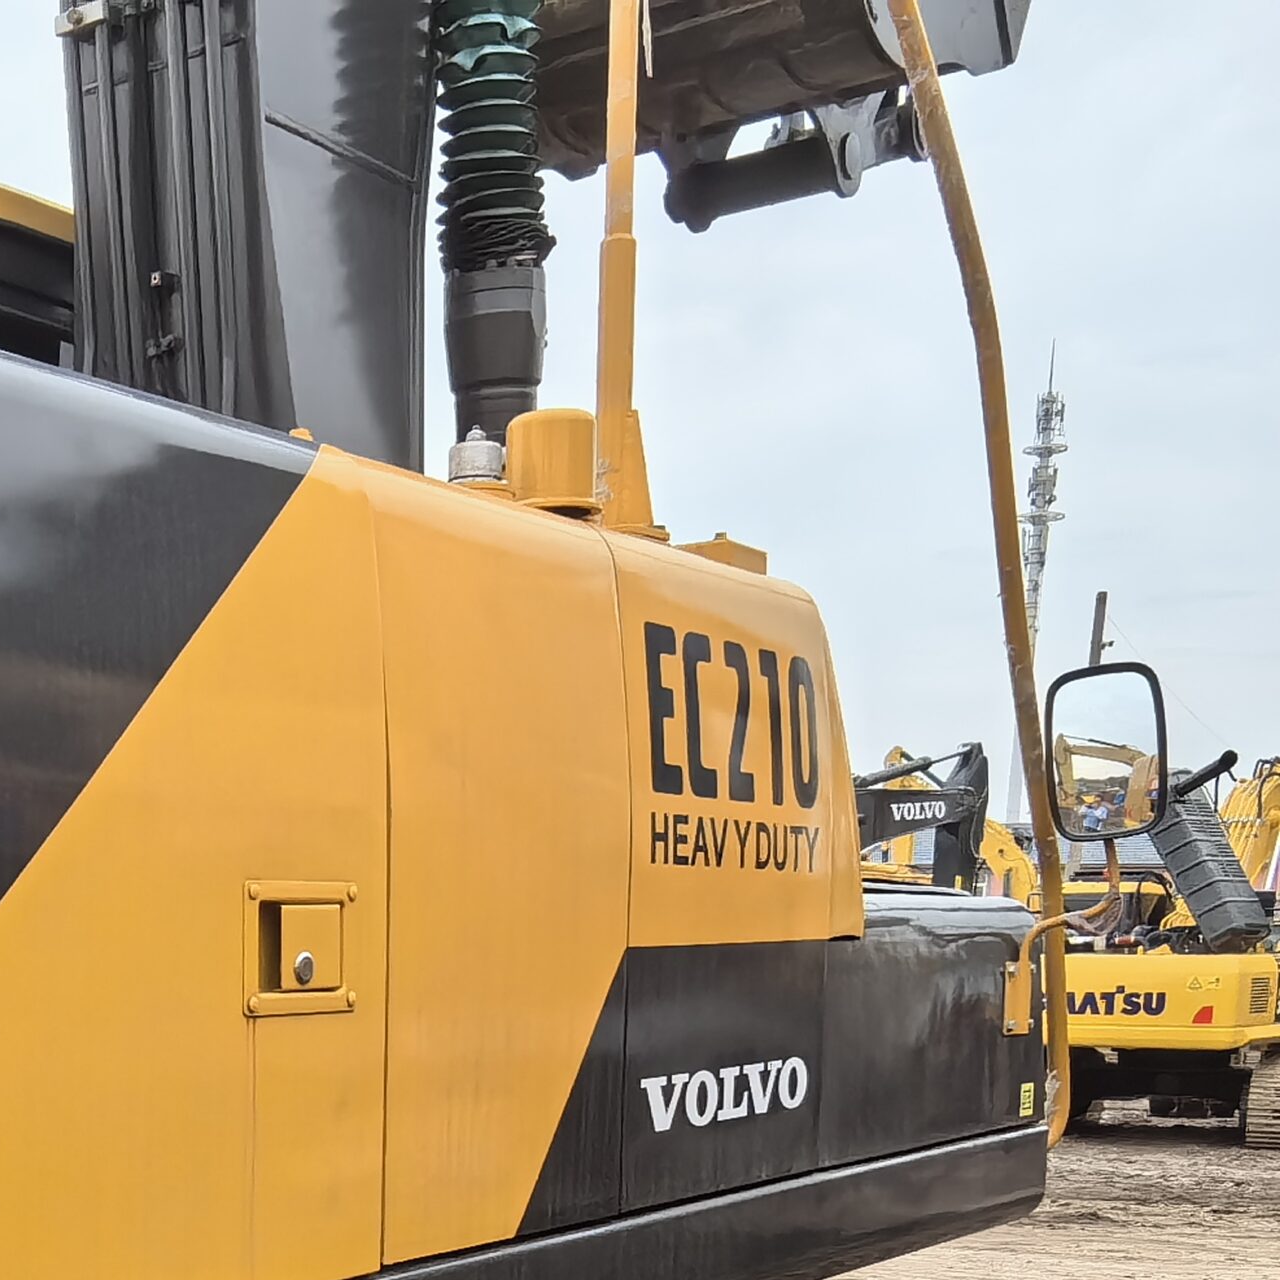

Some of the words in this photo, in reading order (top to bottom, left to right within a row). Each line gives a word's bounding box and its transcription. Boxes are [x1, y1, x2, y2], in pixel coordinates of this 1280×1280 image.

[644, 621, 819, 809] EC210
[890, 801, 946, 821] VOLVO
[640, 1056, 809, 1133] VOLVO
